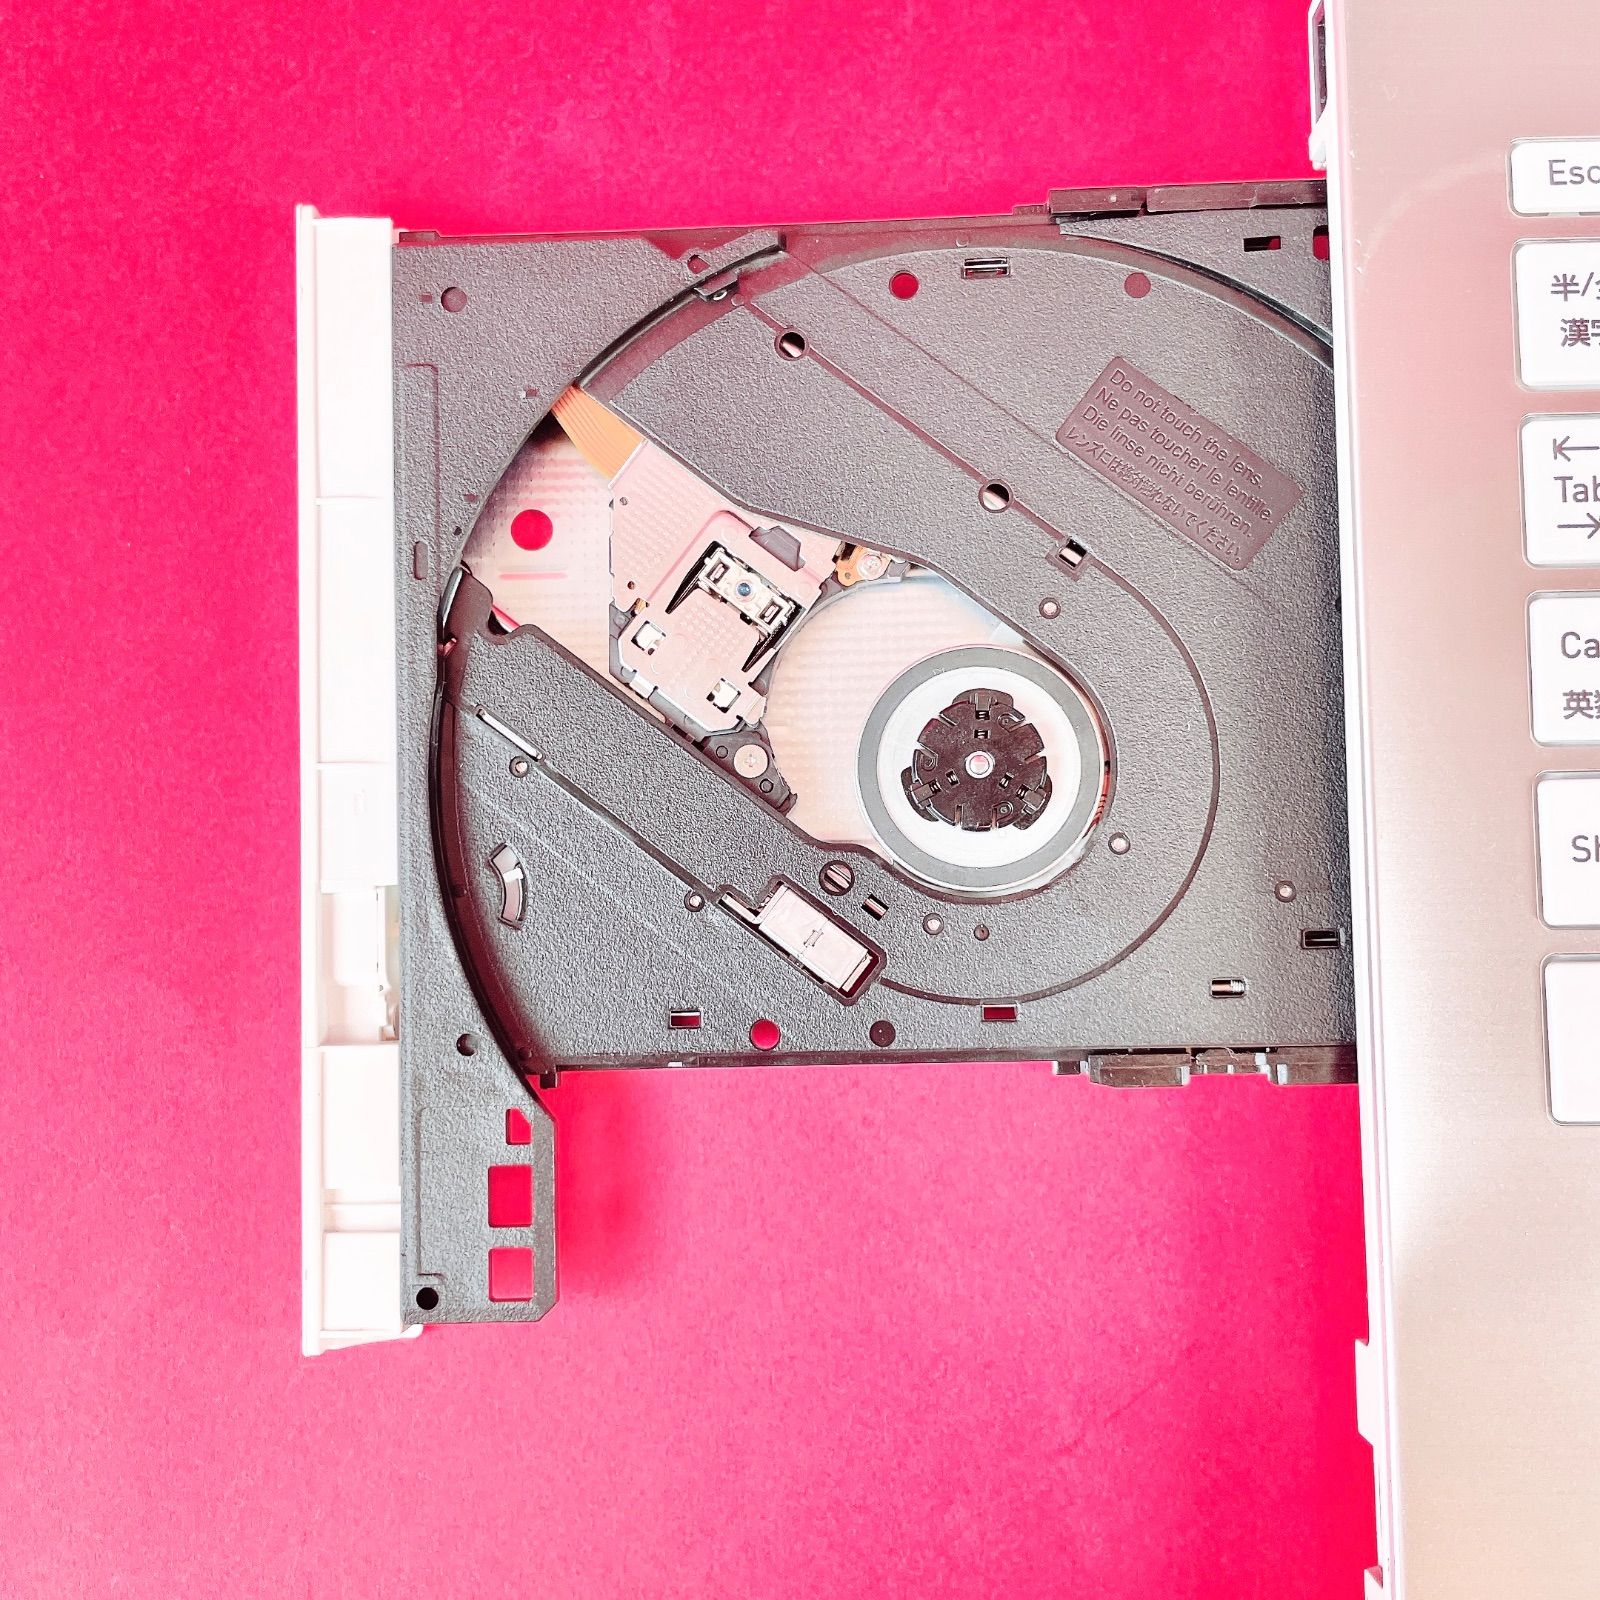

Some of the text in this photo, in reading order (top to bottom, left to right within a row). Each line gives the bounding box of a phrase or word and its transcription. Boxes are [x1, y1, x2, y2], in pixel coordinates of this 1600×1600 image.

[1548, 159, 1600, 185] Esc
[1551, 272, 1600, 301] 半/
[1082, 405, 1252, 537] Die linse nicht berühren.
[1096, 388, 1273, 524] Ne pas toucher le lentille.
[1110, 369, 1263, 488] Do not touch the lens.
